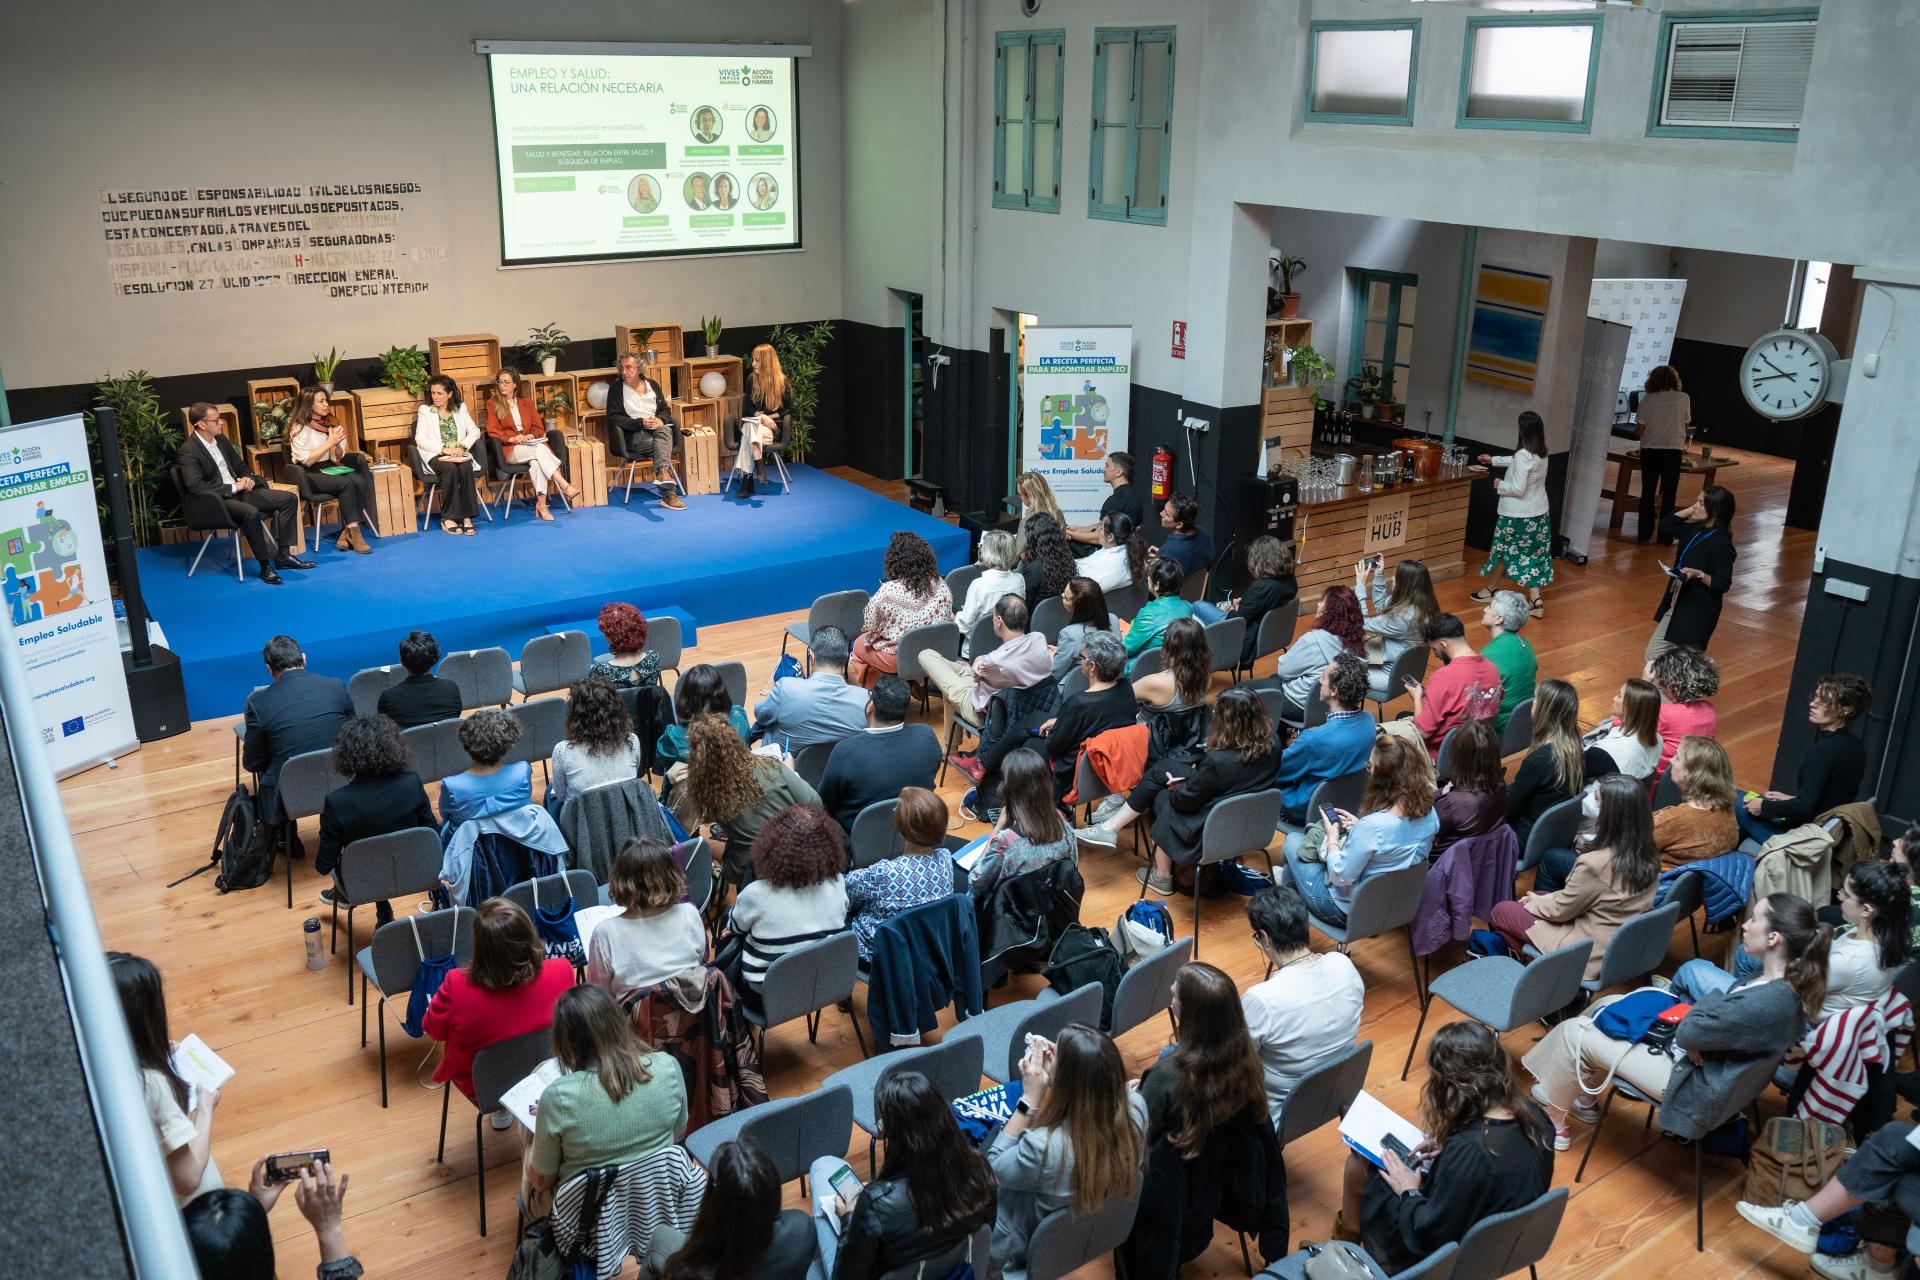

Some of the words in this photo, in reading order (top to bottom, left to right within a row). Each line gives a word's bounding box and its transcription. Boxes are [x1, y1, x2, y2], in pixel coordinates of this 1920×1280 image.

[510, 67, 557, 79] EMPLEO
[561, 68, 567, 78] Y
[570, 68, 610, 79] SALUD:
[510, 82, 537, 94] UNA
[540, 80, 598, 93] RELACIÓN
[602, 82, 664, 93] NECESARIA
[24, 464, 68, 480] PERFECTA
[1052, 468, 1079, 476] Emplea
[50, 472, 86, 488] EMPLEO
[1372, 510, 1403, 523] IMPACT
[1371, 520, 1402, 542] HUB
[18, 630, 54, 647] Emplea
[57, 614, 103, 635] Saludable
